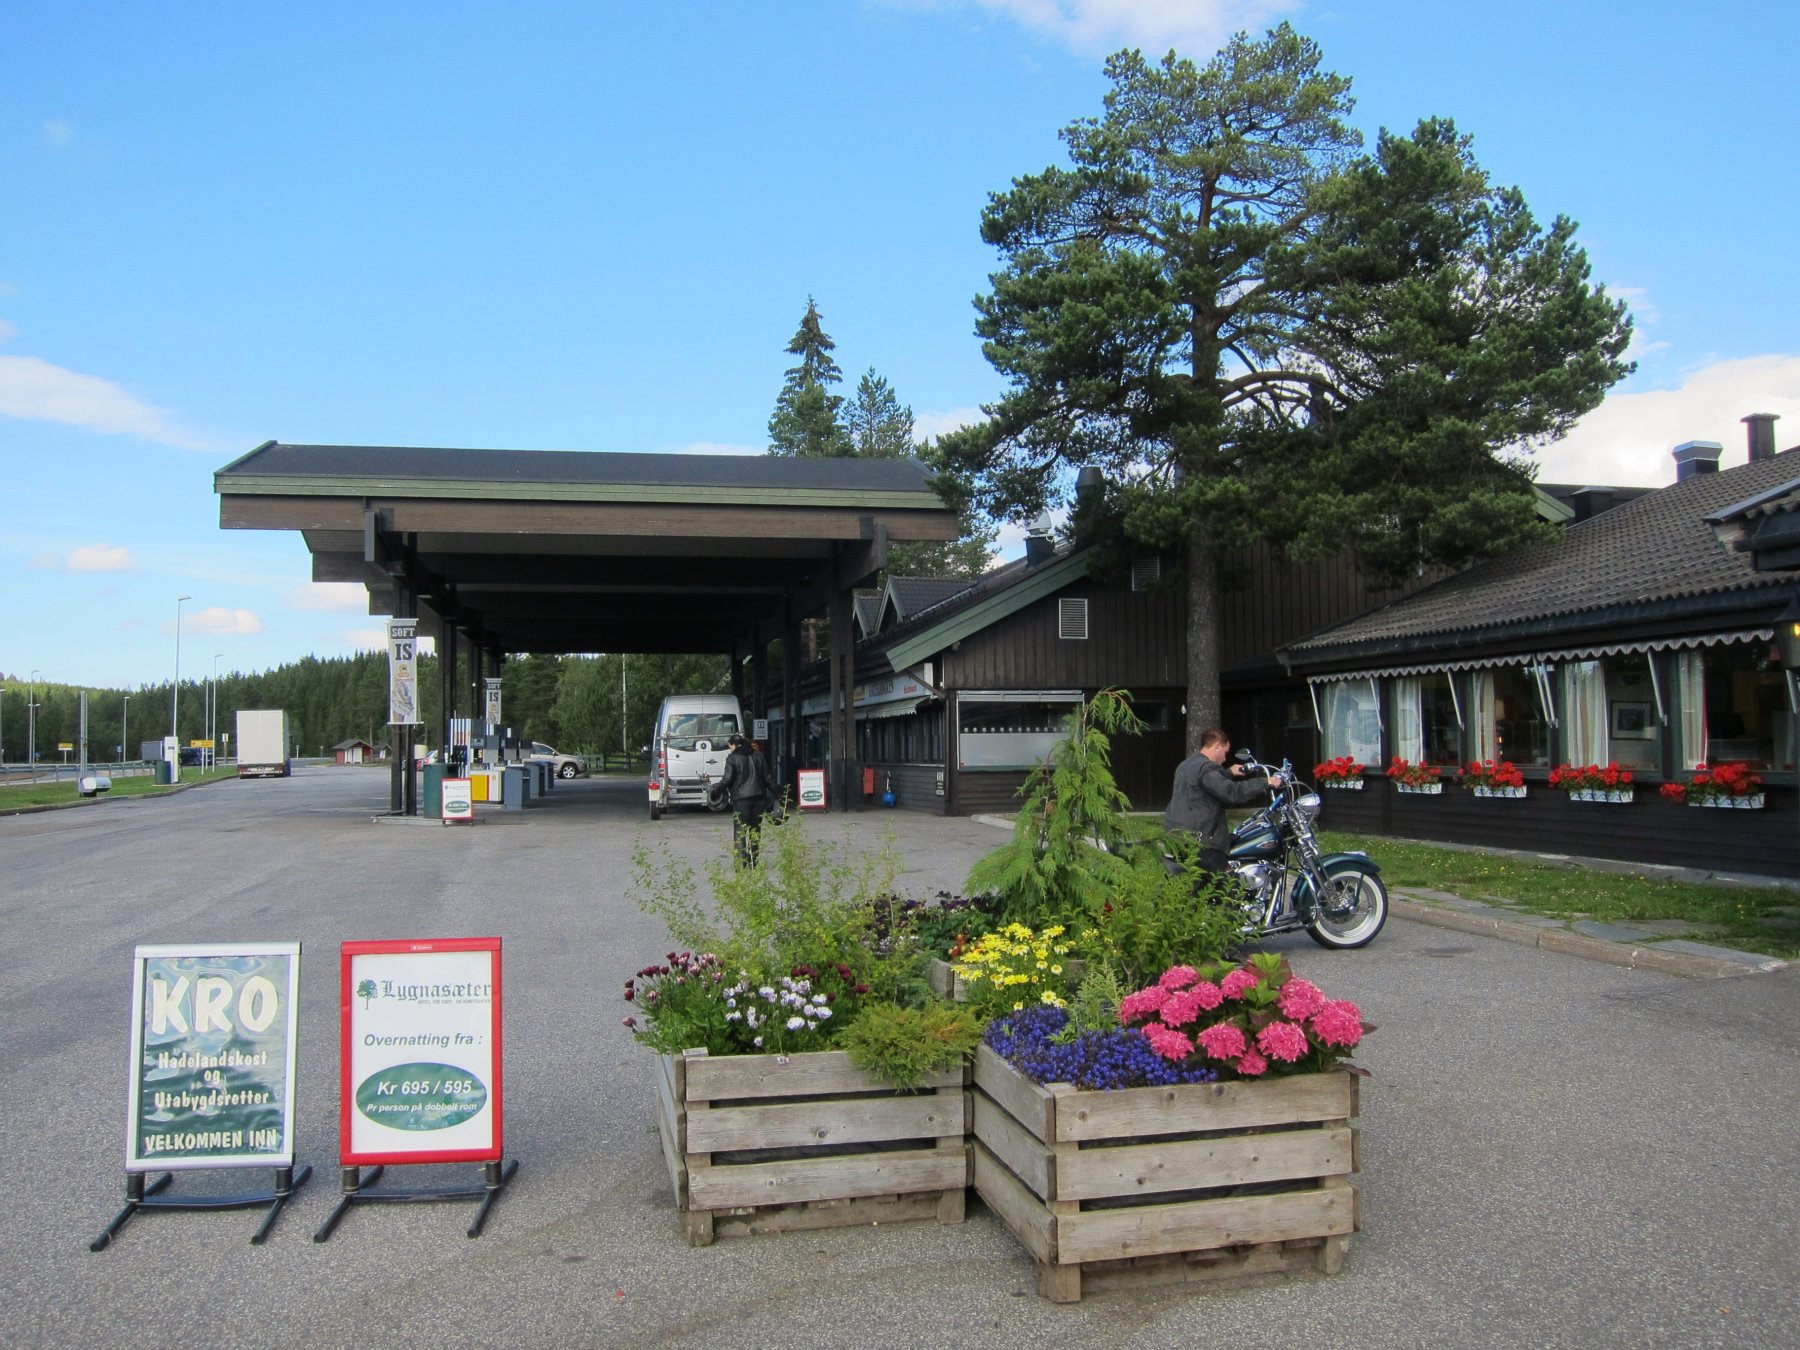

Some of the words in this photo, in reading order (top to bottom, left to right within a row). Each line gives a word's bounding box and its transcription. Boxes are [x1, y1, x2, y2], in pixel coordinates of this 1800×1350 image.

[392, 627, 415, 637] SOFT
[395, 643, 412, 660] IS
[489, 692, 499, 702] IS
[382, 980, 491, 1001] Lygnasæter
[152, 976, 278, 1034] KRO
[364, 1033, 450, 1048] Overnatting
[454, 1033, 473, 1045] fra
[158, 1050, 267, 1069] Hadelandskost
[204, 1070, 220, 1083] og
[377, 1081, 397, 1095] Kr
[401, 1081, 429, 1094] 695
[432, 1080, 440, 1094] /
[444, 1080, 472, 1094] 595
[154, 1090, 269, 1110] Utabygdsretter
[366, 1103, 377, 1112] Pr
[379, 1103, 409, 1113] person
[411, 1103, 422, 1112] på
[144, 1132, 242, 1151] VELKOMMEN
[249, 1130, 277, 1146] INN
